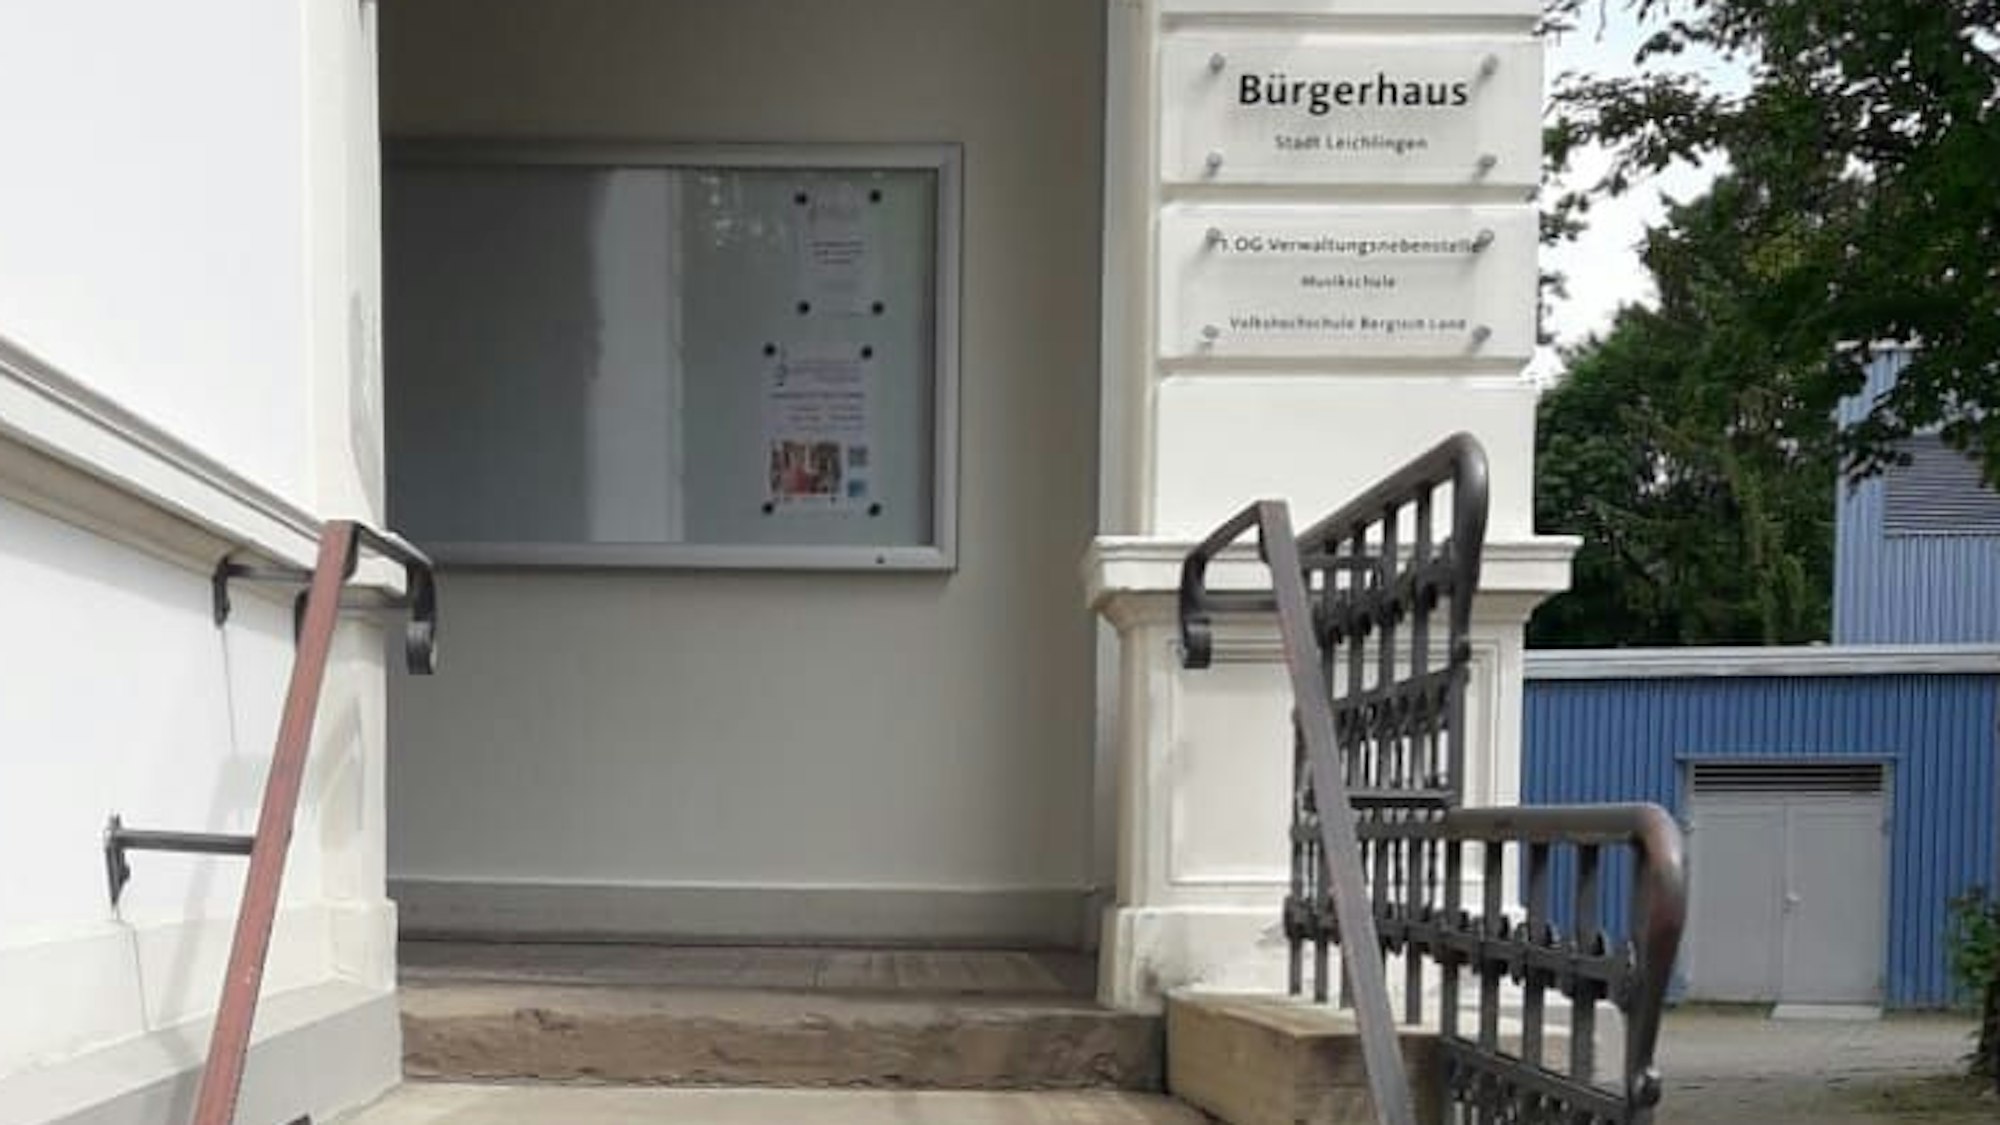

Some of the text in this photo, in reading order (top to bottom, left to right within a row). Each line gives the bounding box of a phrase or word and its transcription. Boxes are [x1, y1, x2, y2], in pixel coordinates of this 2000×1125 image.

[1239, 73, 1469, 115] Bürgerhaus
[1275, 134, 1428, 154] Stadt Leichlingen
[1236, 236, 1262, 251] OG
[1301, 274, 1396, 289] Musikschule
[1230, 314, 1354, 330] Volkshochschule
[1429, 316, 1467, 331] Land
